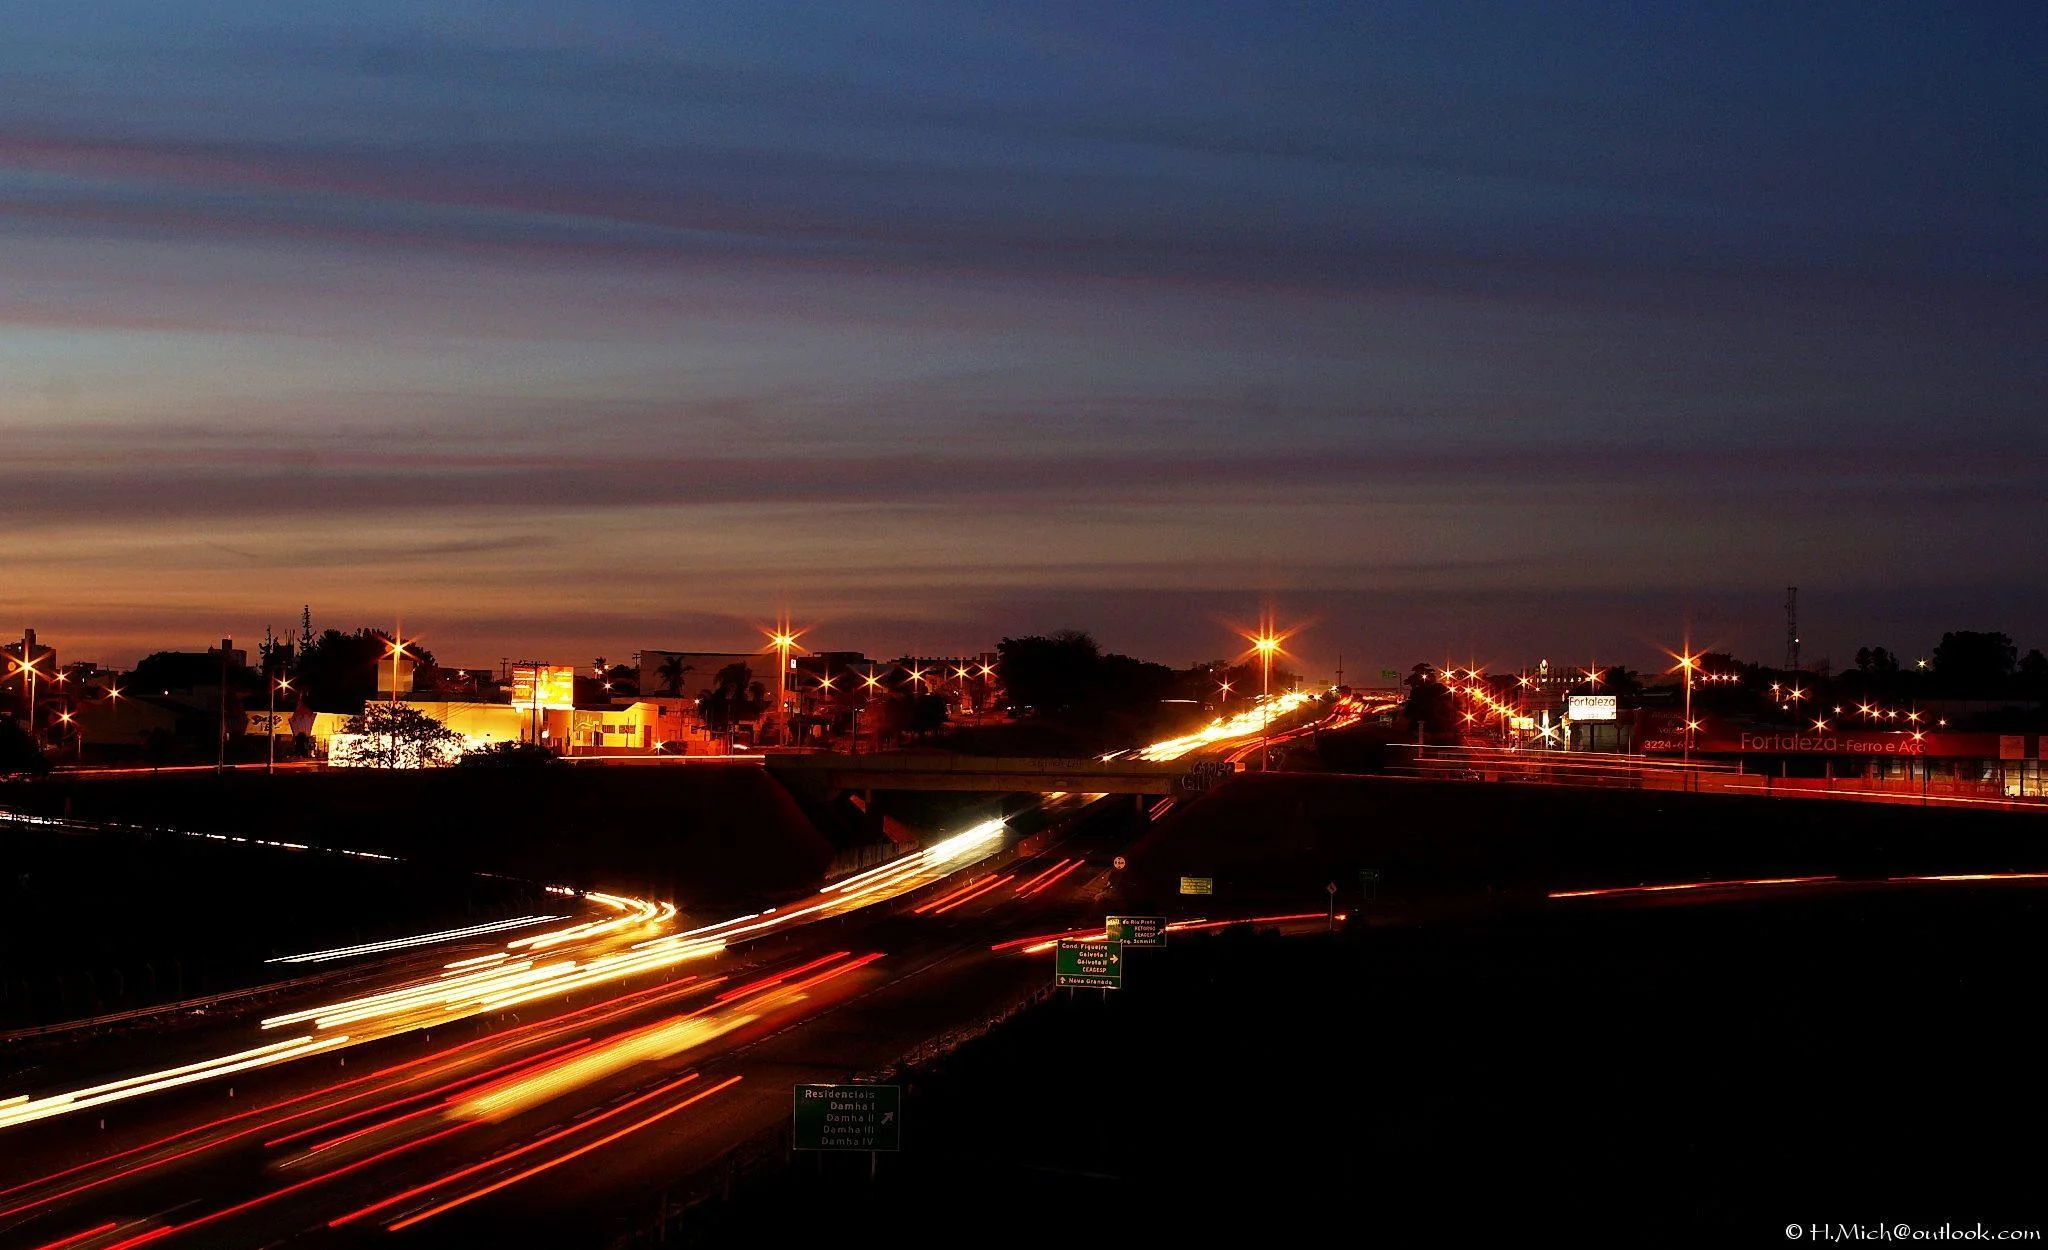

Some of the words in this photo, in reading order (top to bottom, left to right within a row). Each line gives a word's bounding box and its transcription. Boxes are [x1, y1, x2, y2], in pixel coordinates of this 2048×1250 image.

[1569, 696, 1615, 706] Fortaleza
[1741, 732, 1837, 751] Fortaleza
[1846, 740, 1882, 752] Ferro
[1885, 742, 1895, 752] e
[805, 1089, 875, 1099] Residenciais
[830, 1101, 868, 1111] Damha
[872, 1102, 875, 1110] I
[826, 1113, 864, 1123] Damha
[868, 1114, 874, 1123] II
[823, 1125, 861, 1134] Damha
[864, 1125, 874, 1134] III
[821, 1136, 859, 1146] Damha
[862, 1138, 874, 1146] IV
